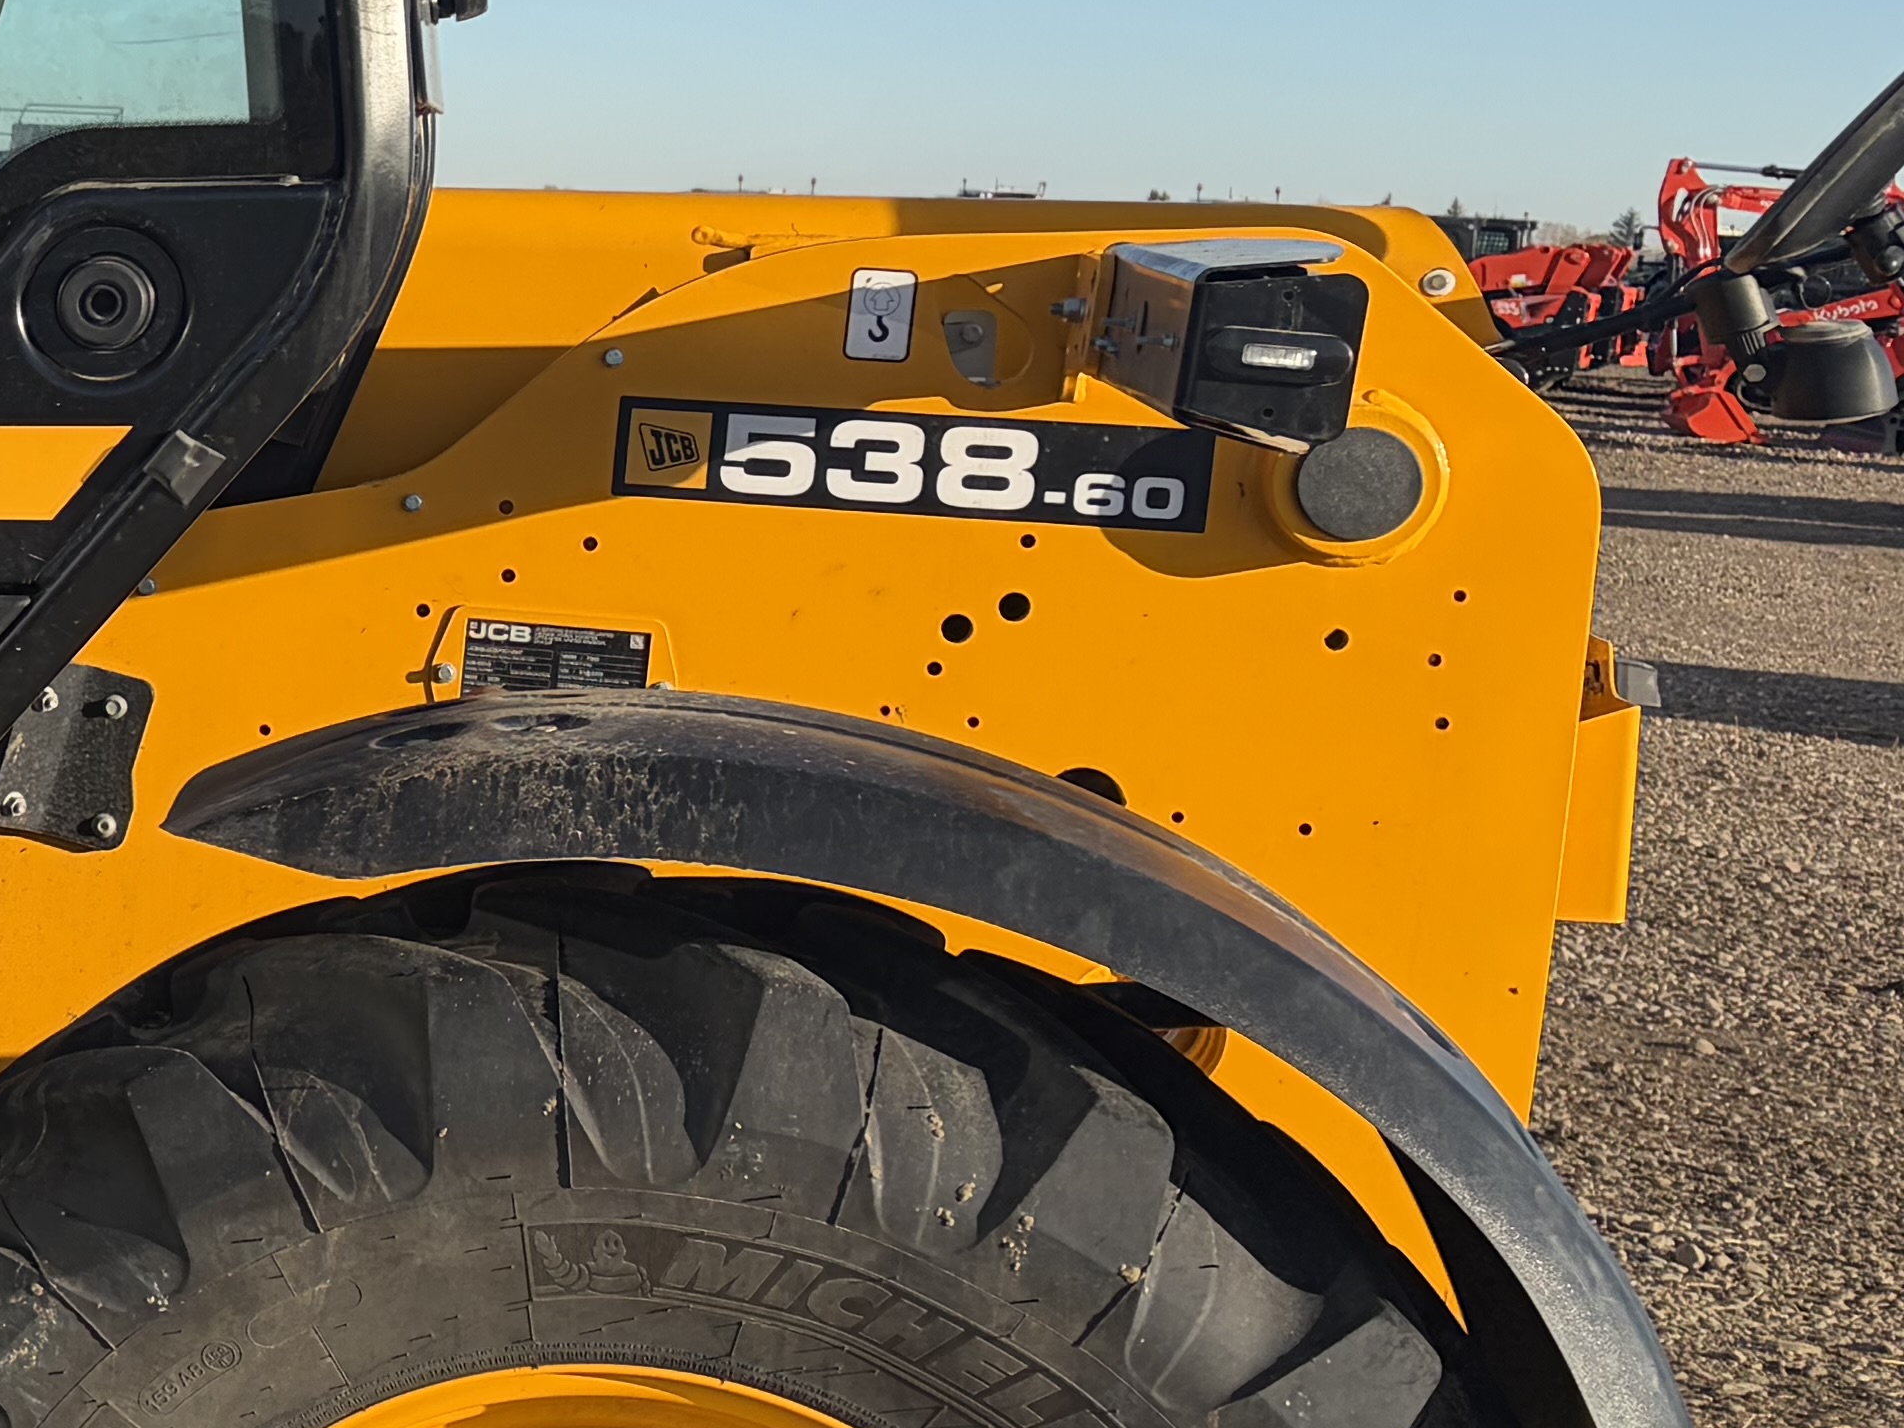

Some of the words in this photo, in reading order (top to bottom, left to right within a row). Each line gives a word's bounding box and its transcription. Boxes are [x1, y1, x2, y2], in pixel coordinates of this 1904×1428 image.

[1814, 299, 1879, 323] Kubota
[647, 427, 699, 467] JCB
[468, 621, 532, 643] JCB
